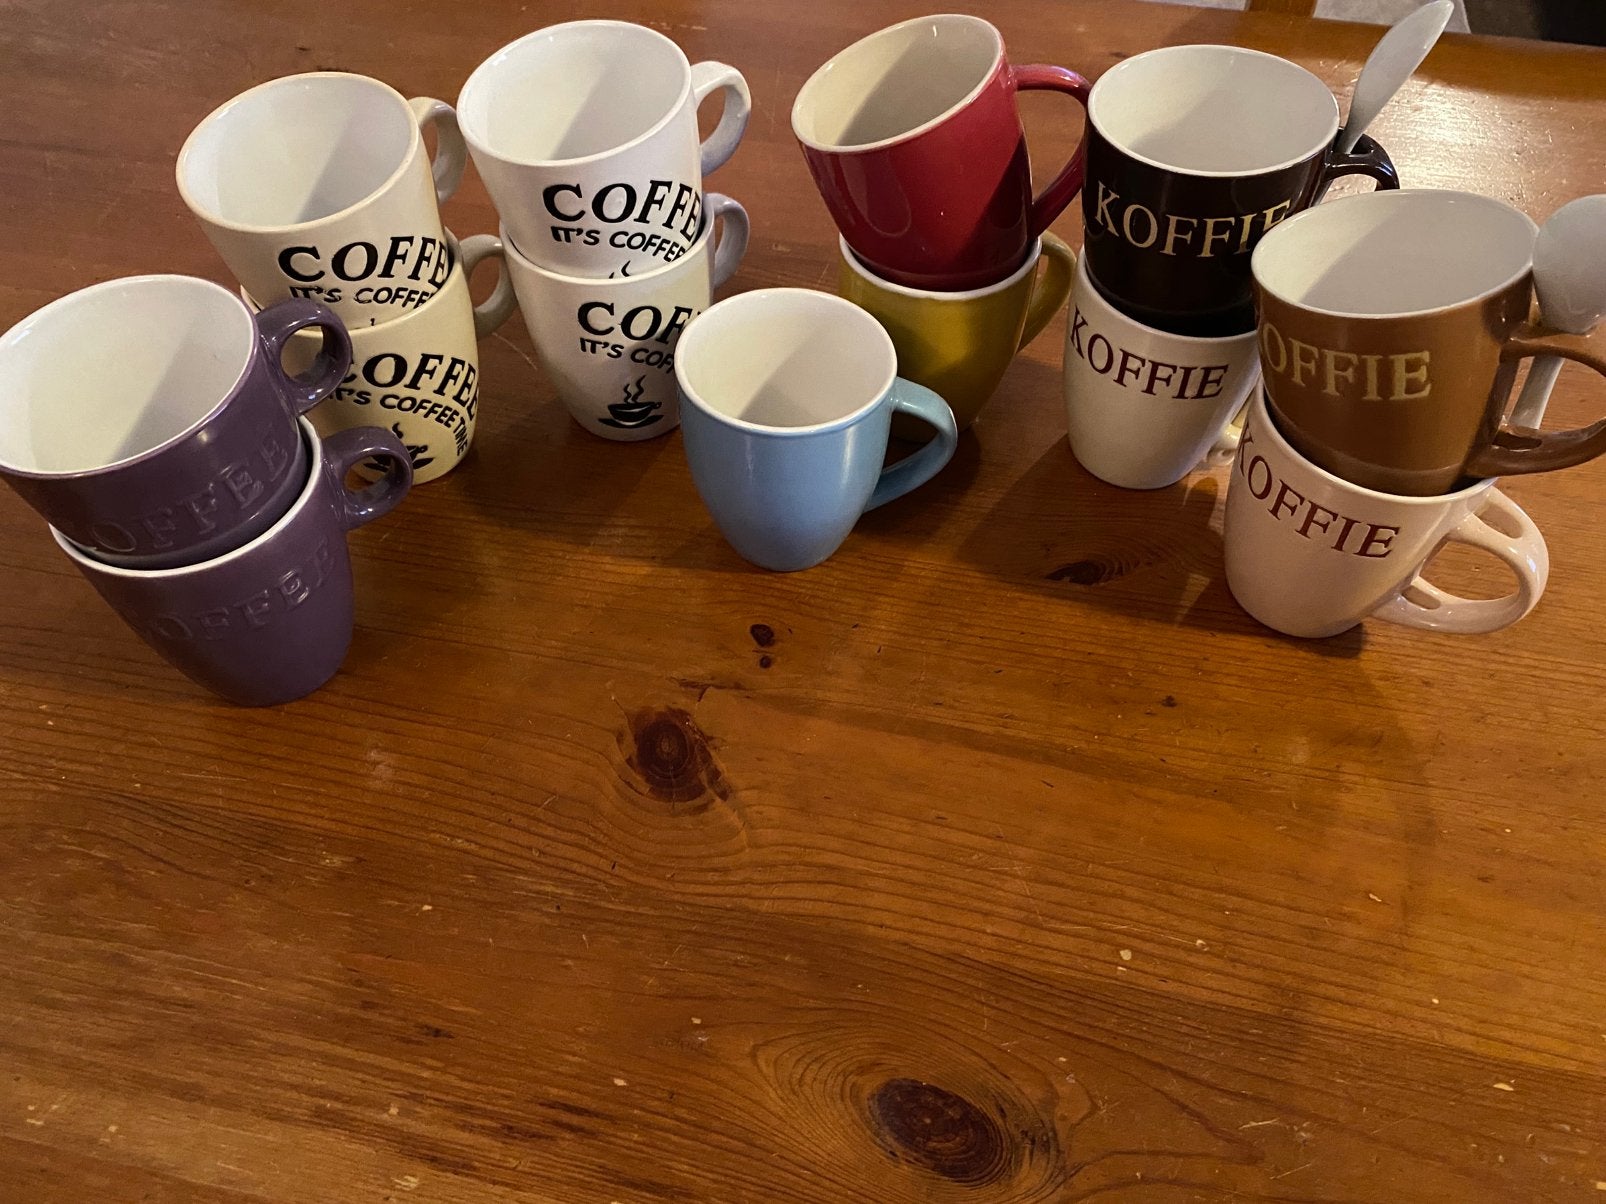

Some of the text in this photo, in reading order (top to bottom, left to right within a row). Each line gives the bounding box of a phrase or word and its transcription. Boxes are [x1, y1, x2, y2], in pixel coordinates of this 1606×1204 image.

[550, 226, 601, 246] IT'S
[353, 286, 434, 309] COFFE
[577, 301, 702, 345] COF
[579, 338, 624, 359] IT'S
[1070, 304, 1229, 400] KOFFIE
[1260, 322, 1432, 401] OFFIE
[329, 387, 468, 457] T'S COFFEE TIME
[341, 353, 478, 422] OFFEE
[1237, 421, 1401, 558] KOFFIE
[142, 537, 334, 641] OFFEE
